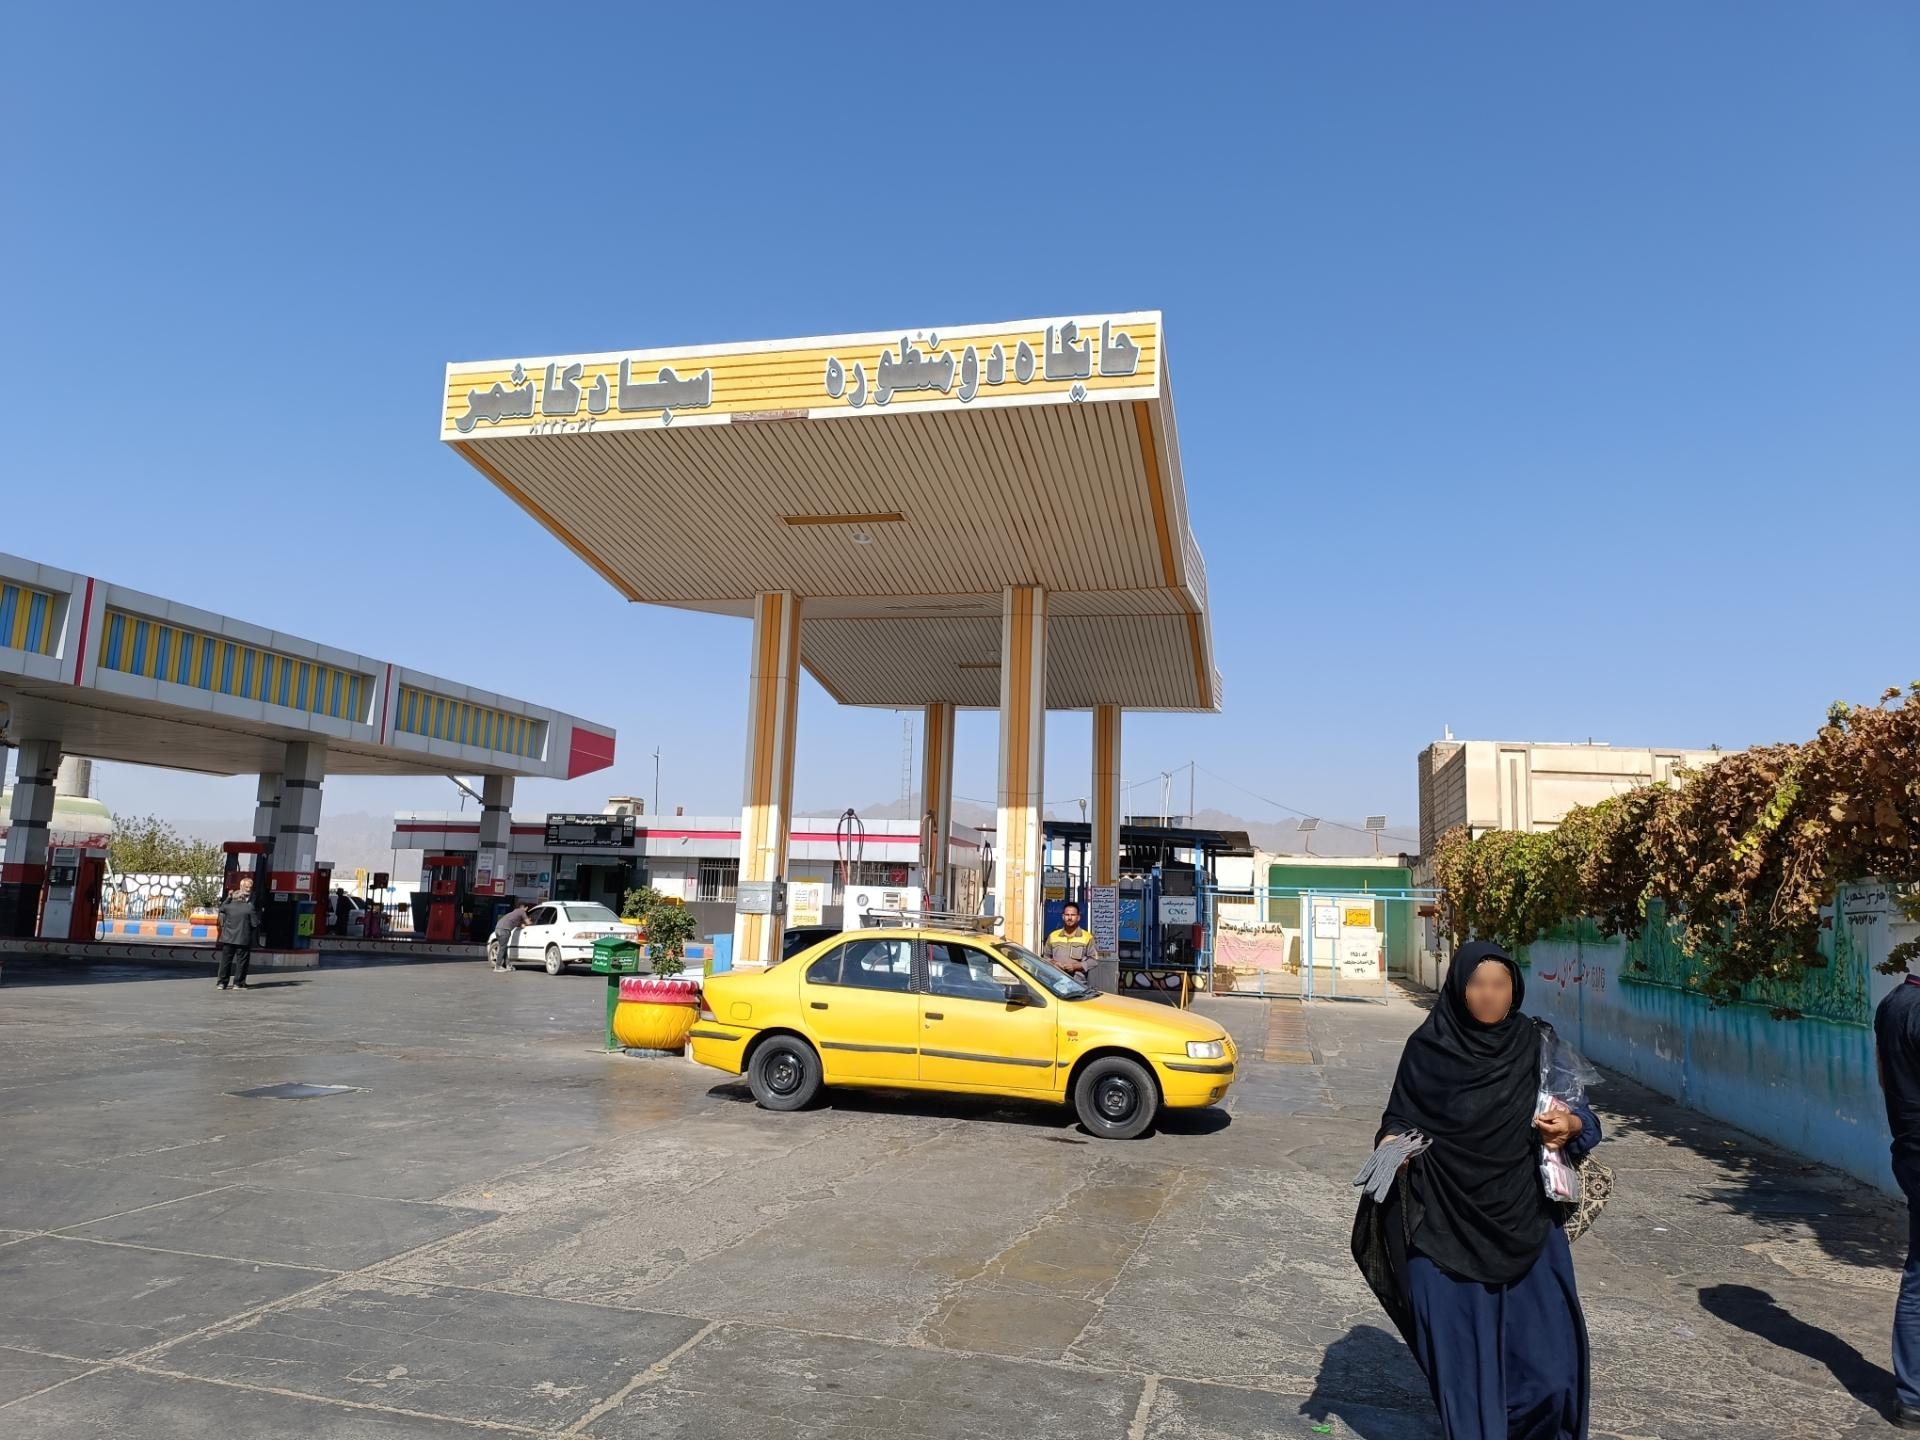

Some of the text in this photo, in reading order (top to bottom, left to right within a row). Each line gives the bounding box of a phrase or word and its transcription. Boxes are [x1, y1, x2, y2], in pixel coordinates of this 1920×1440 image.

[455, 361, 583, 433] کاشمر
[587, 357, 713, 427] سجاد
[824, 331, 956, 408] منظوره
[956, 341, 1006, 402] دو
[1168, 908, 1188, 916] CNG
